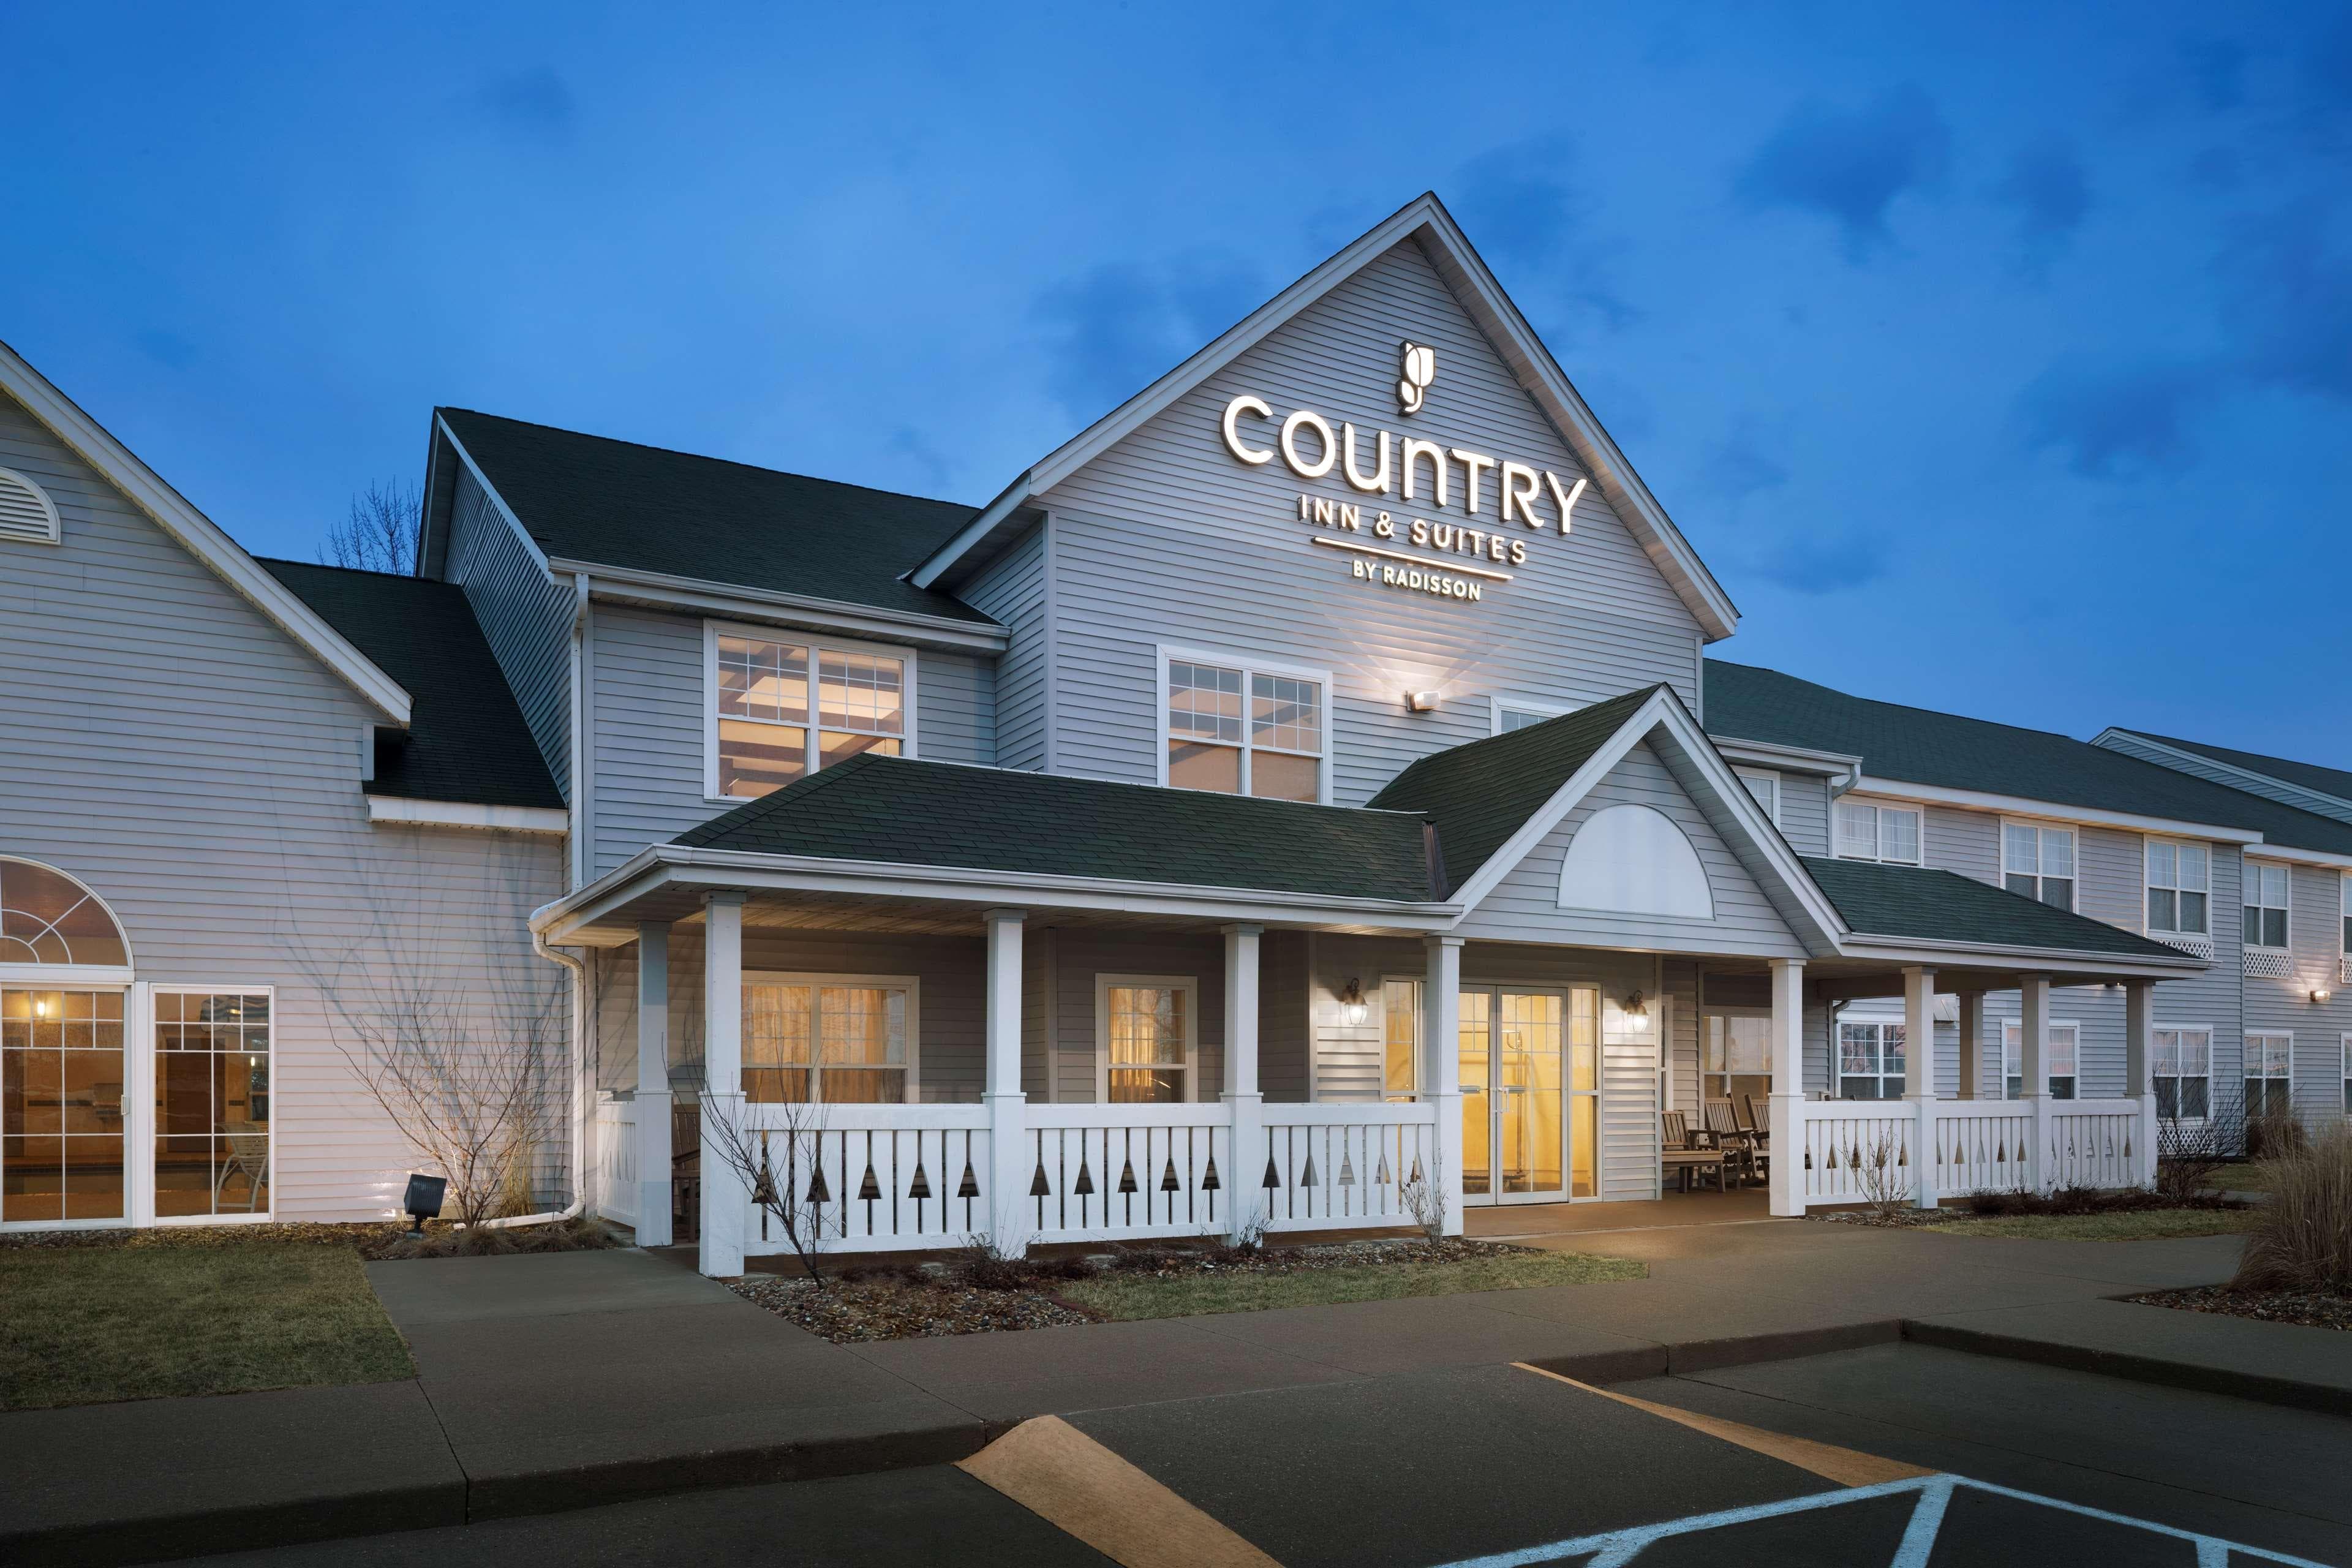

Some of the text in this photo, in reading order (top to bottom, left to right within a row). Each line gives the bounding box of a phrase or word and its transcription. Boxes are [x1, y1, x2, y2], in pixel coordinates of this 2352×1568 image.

[1297, 494, 1526, 565] INN & SUITES
[1352, 559, 1480, 601] BY RADISSON
